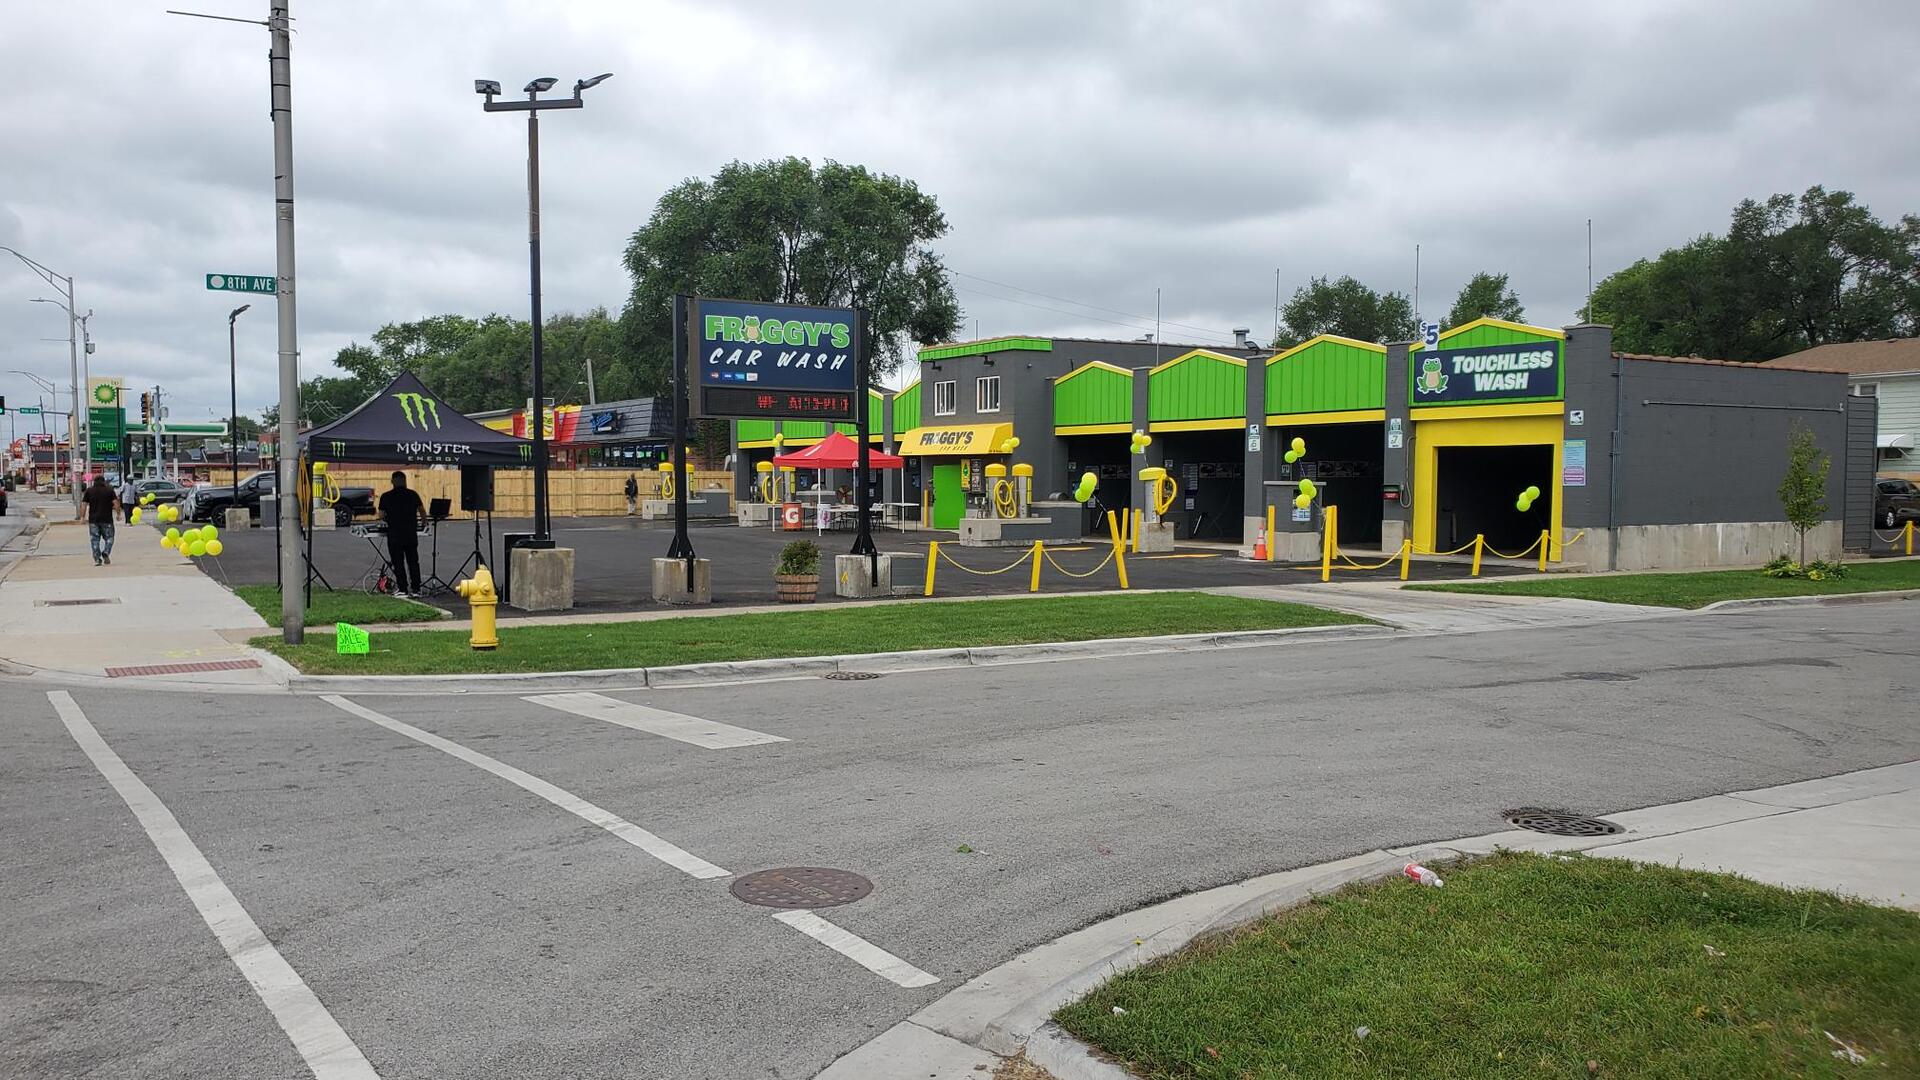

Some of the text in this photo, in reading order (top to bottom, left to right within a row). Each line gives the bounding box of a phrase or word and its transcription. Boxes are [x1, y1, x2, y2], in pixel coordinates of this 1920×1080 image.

[228, 277, 272, 291] 8TH AVE
[705, 315, 850, 349] FROGGY'S
[1421, 322, 1438, 345] $5
[709, 347, 847, 371] CAR WASH
[1452, 350, 1554, 374] TOUCHLESS
[1474, 372, 1529, 392] WASH
[396, 441, 472, 455] MONSTER
[785, 507, 799, 524] G
